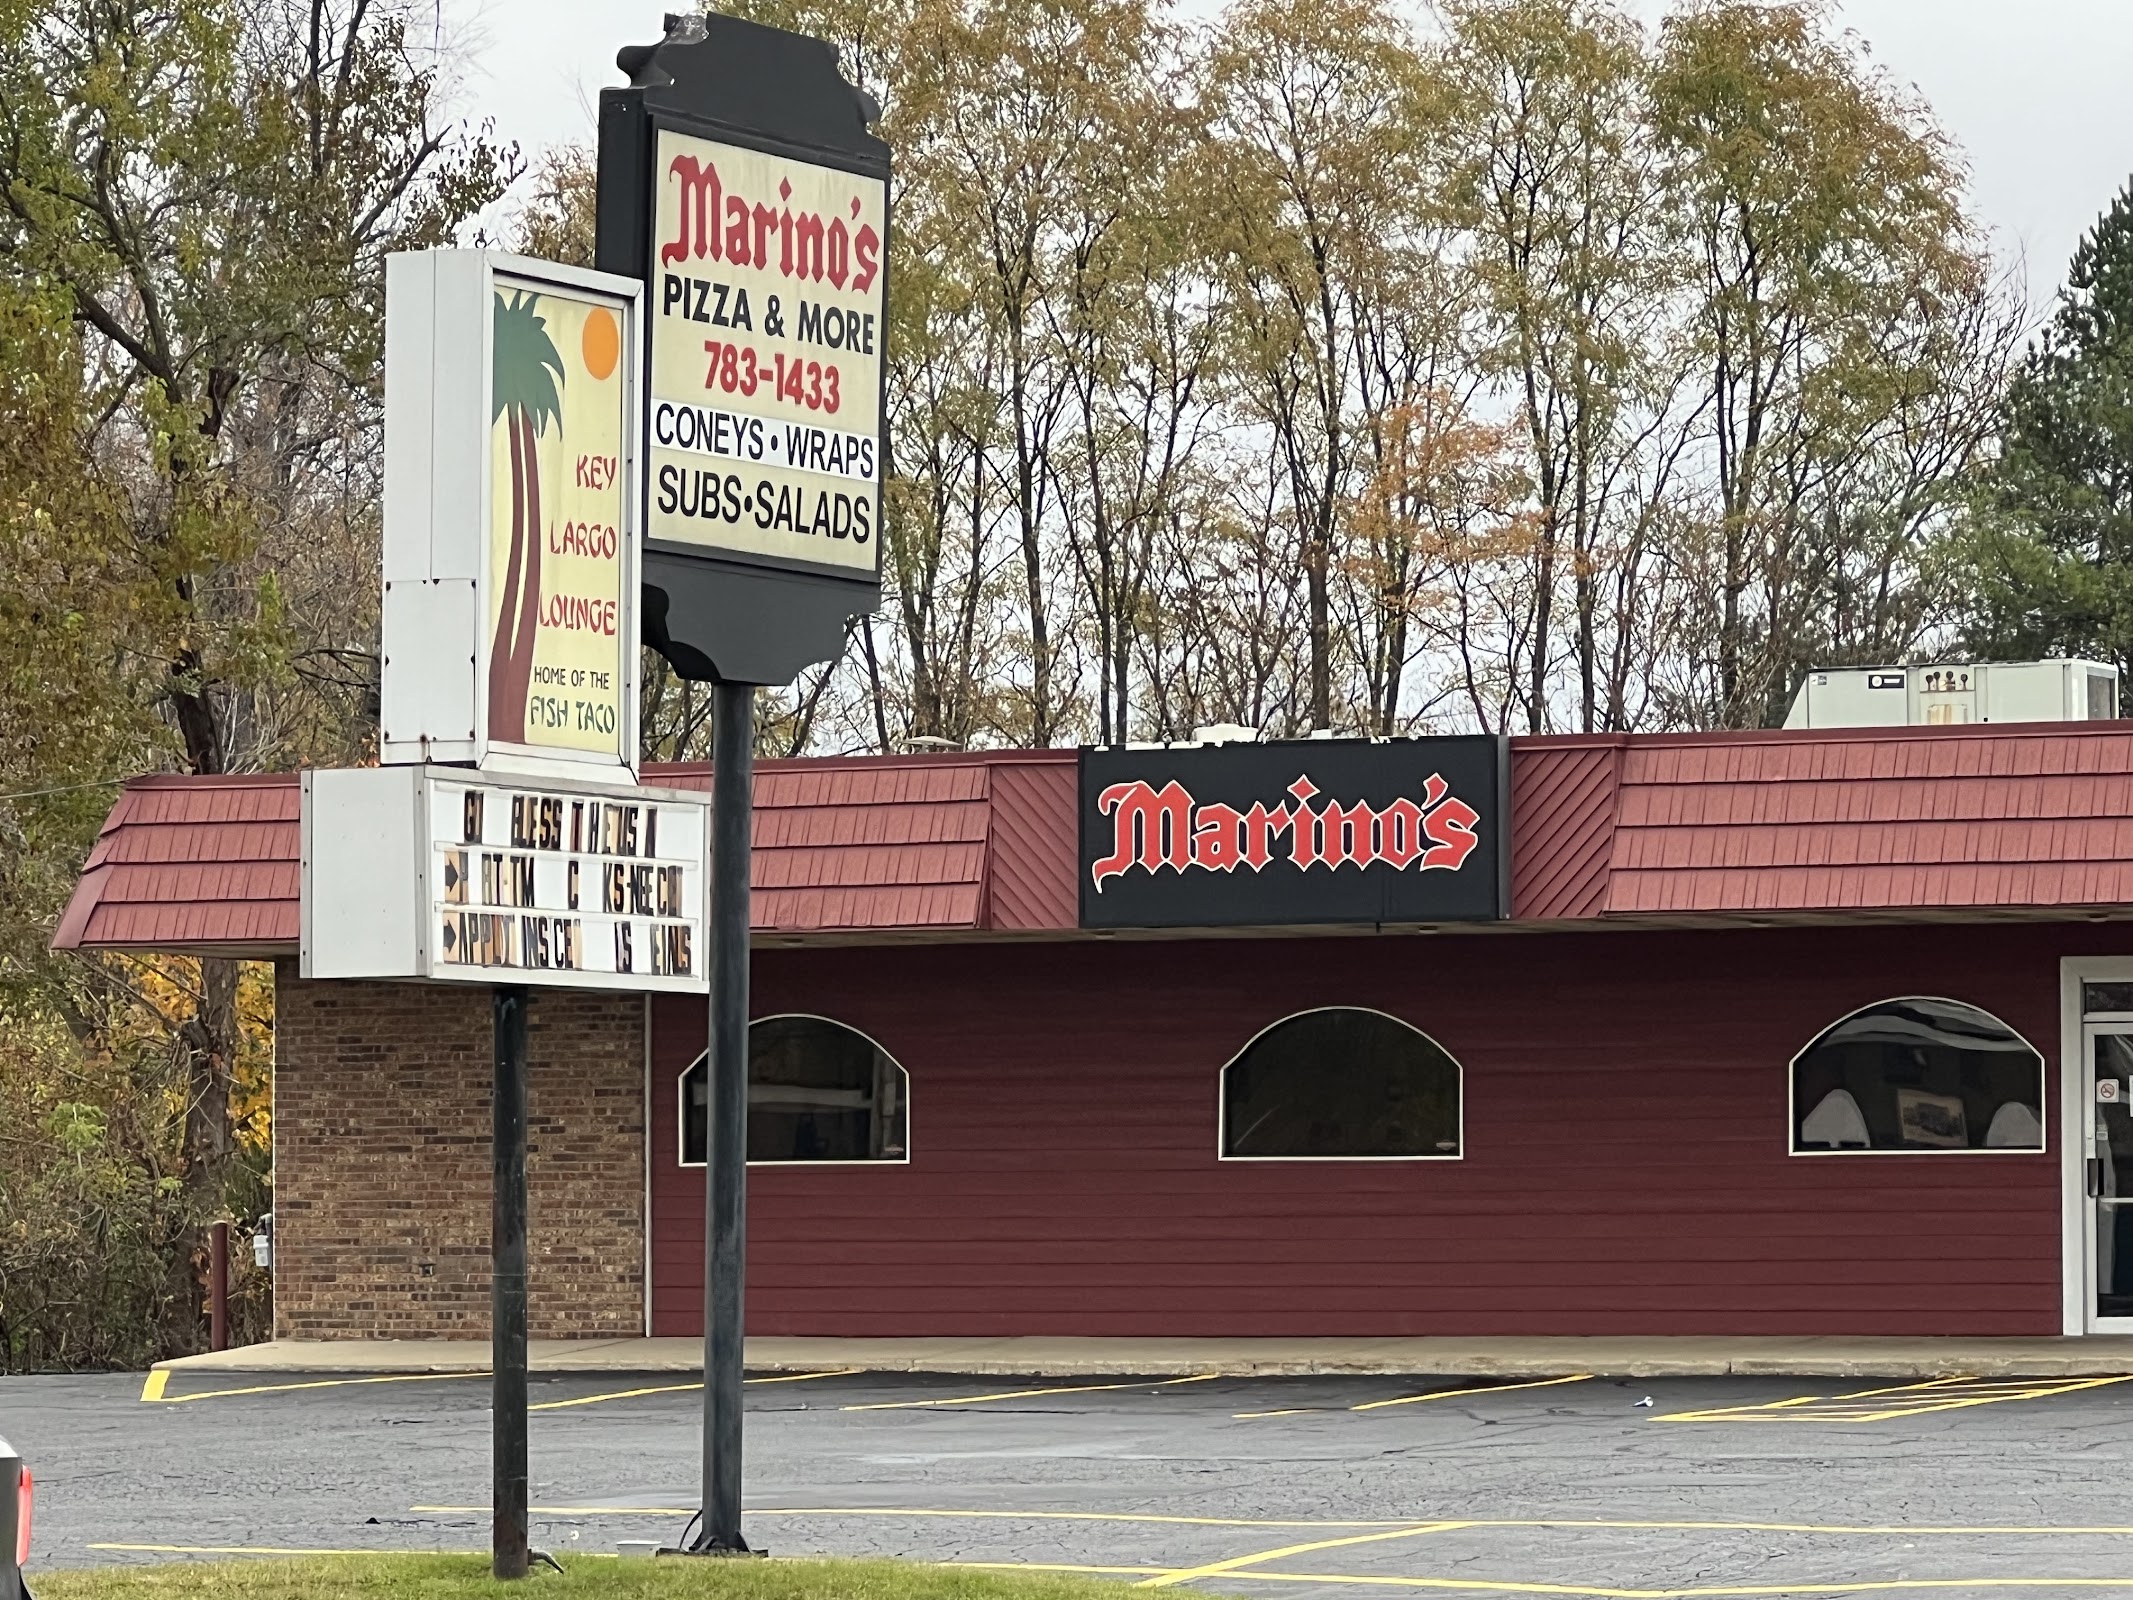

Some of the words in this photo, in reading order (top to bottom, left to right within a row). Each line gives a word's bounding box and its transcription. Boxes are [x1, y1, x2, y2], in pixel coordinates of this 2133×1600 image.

[661, 154, 880, 295] Marino's
[663, 273, 752, 331] PIZZA
[764, 294, 785, 338] &
[797, 300, 874, 355] MORE
[704, 340, 840, 414] 783-1433
[656, 403, 764, 460] CONEYS
[785, 425, 874, 478] WRAPS
[576, 453, 617, 490] KEY
[549, 518, 617, 560] LARGO
[539, 591, 616, 636] LOUNGE
[534, 666, 566, 687] HOME
[571, 668, 586, 687] OF
[590, 670, 610, 690] THE
[530, 695, 568, 729] FISH
[576, 700, 615, 735] TACO
[1092, 772, 1481, 894] Marino's
